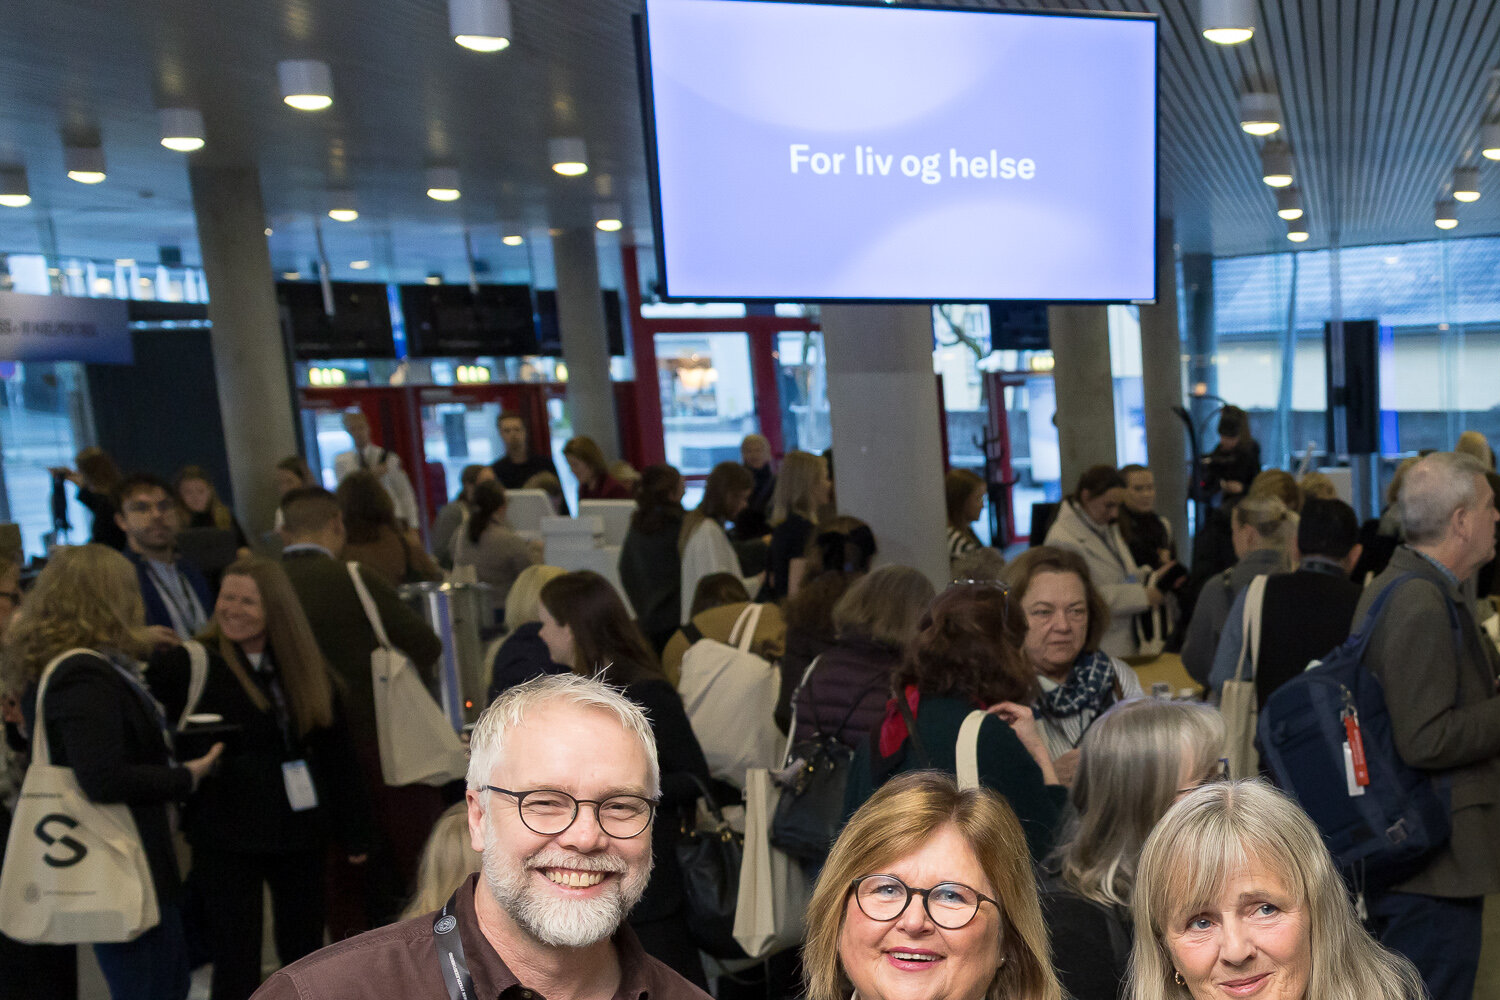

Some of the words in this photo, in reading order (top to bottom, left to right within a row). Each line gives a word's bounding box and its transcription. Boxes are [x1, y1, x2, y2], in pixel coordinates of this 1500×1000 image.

[789, 144, 846, 174] For
[855, 145, 894, 176] liv
[900, 152, 942, 185] og
[949, 148, 1036, 180] helse
